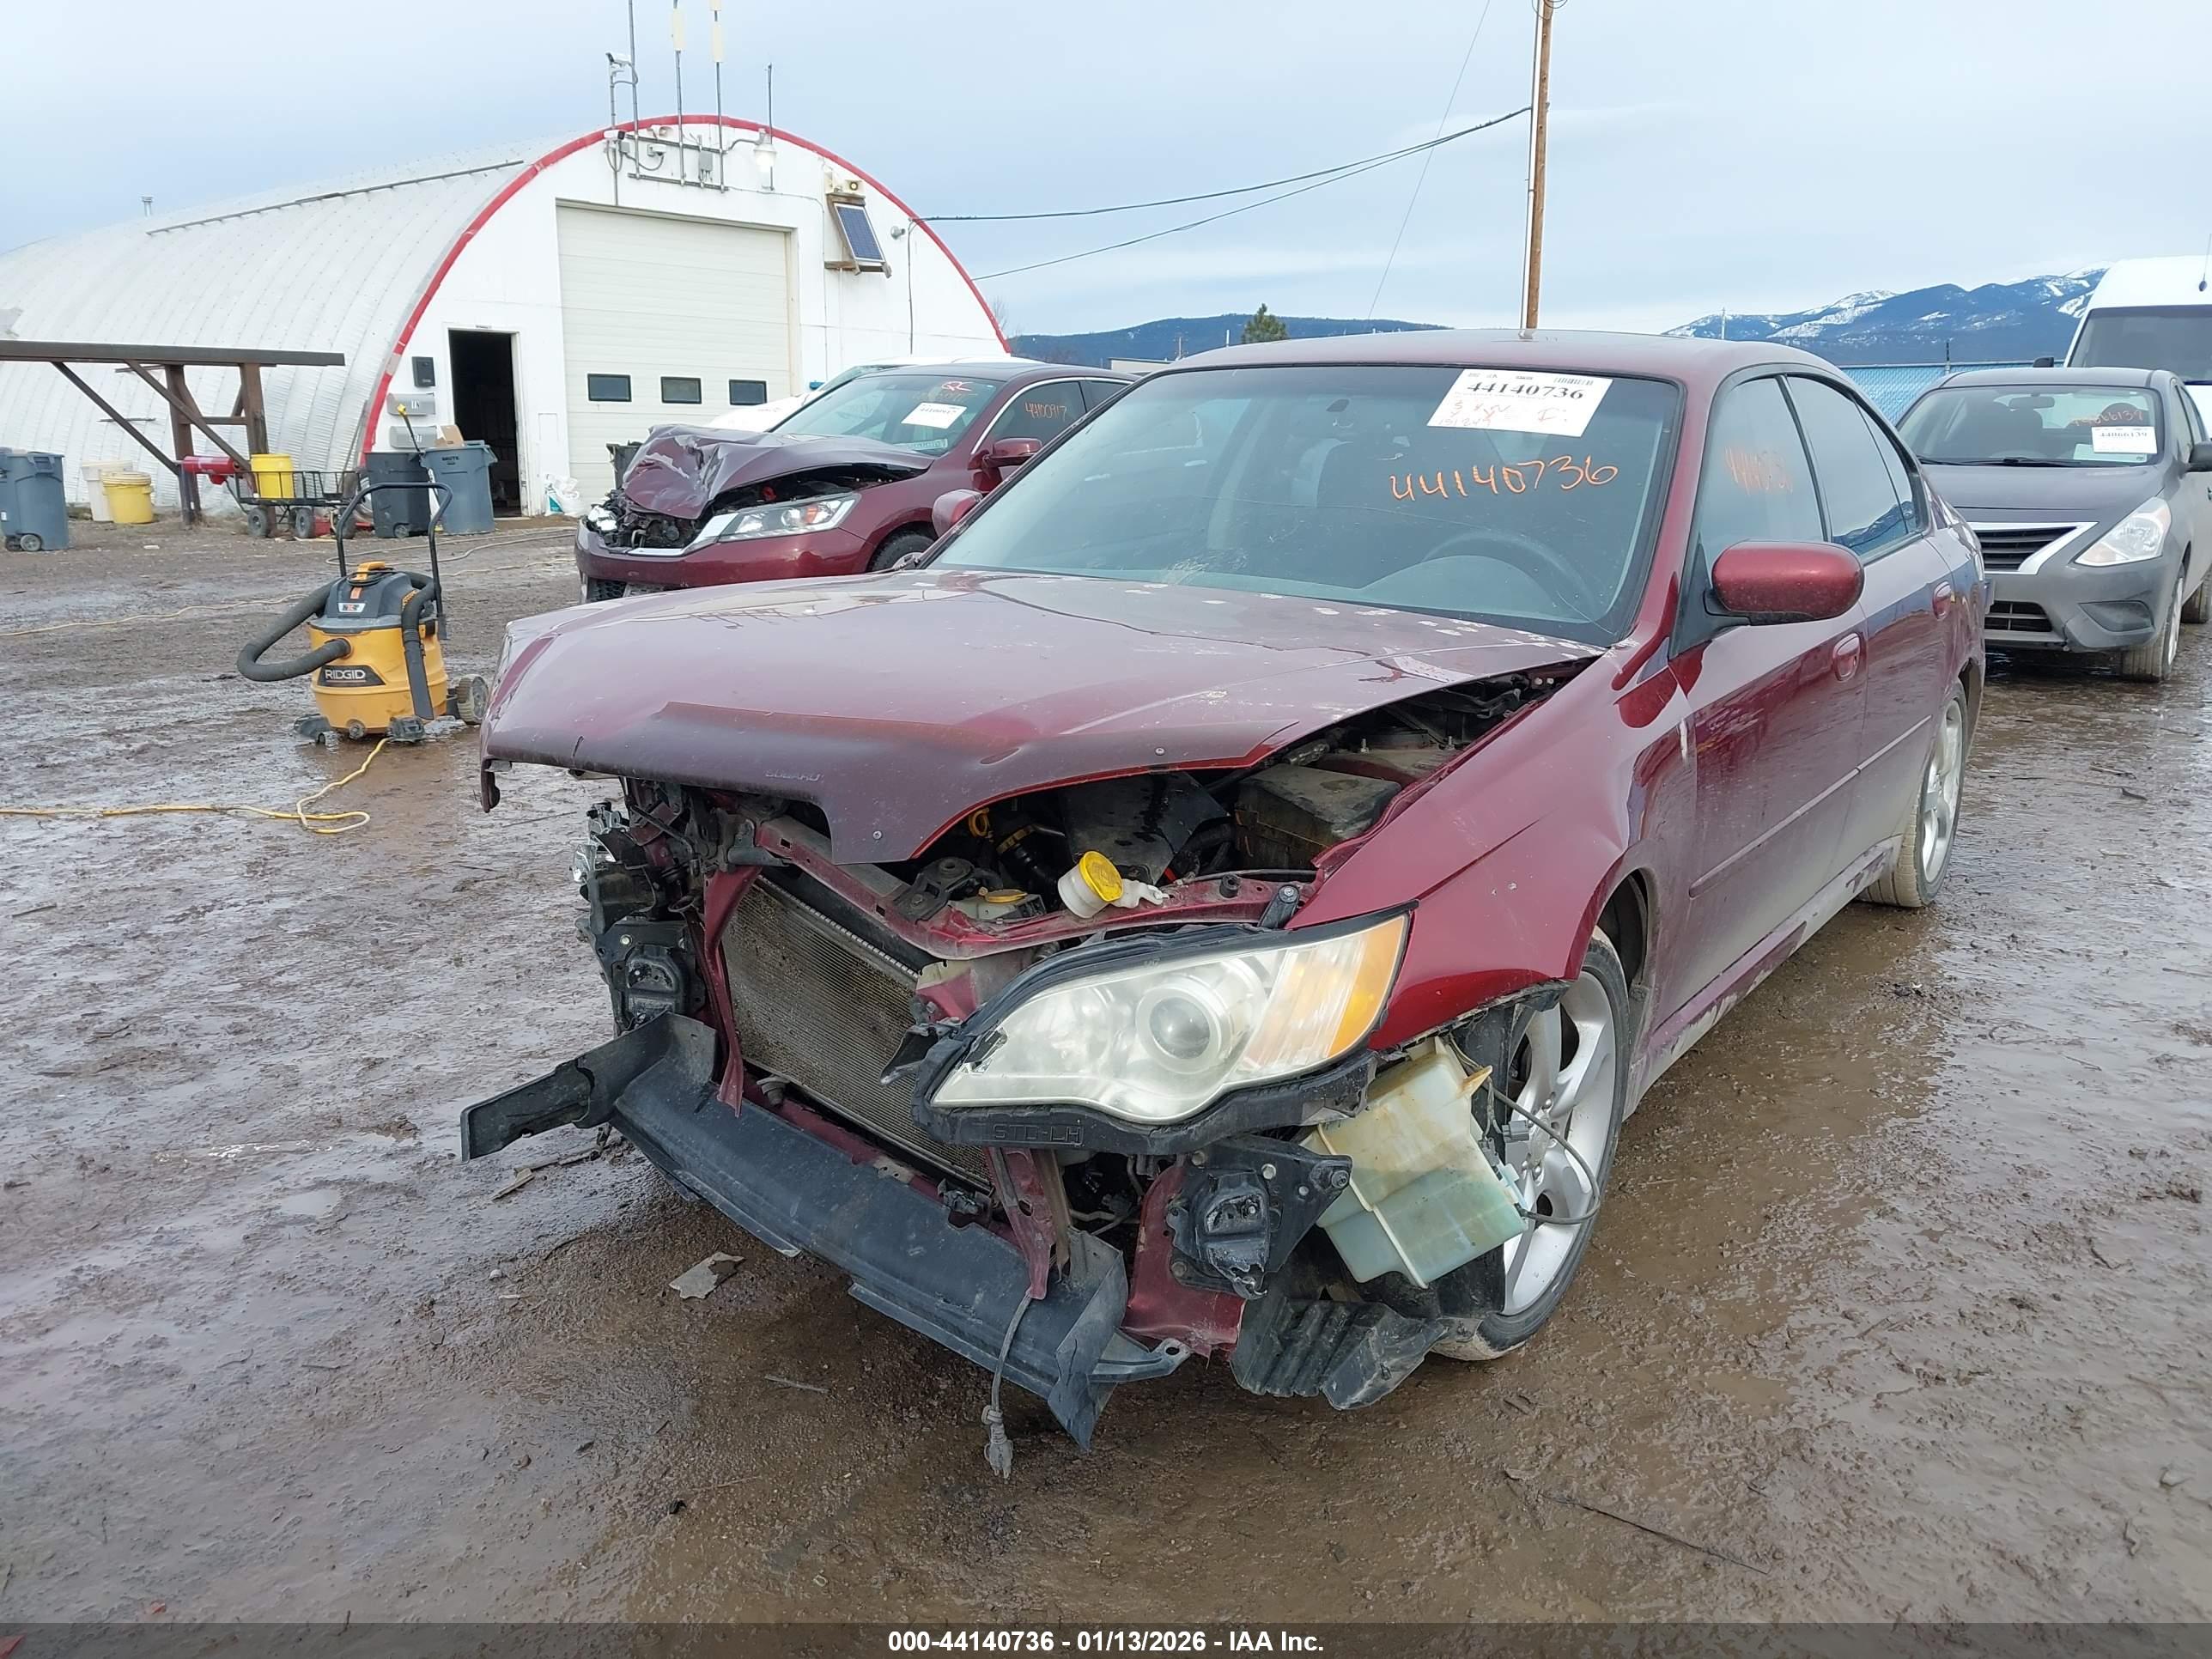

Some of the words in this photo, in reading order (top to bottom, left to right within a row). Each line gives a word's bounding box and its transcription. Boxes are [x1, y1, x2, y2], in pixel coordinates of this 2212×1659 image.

[1466, 380, 1584, 400] 44140736
[1389, 455, 1618, 501] 44140736
[325, 670, 366, 680] RIDGID
